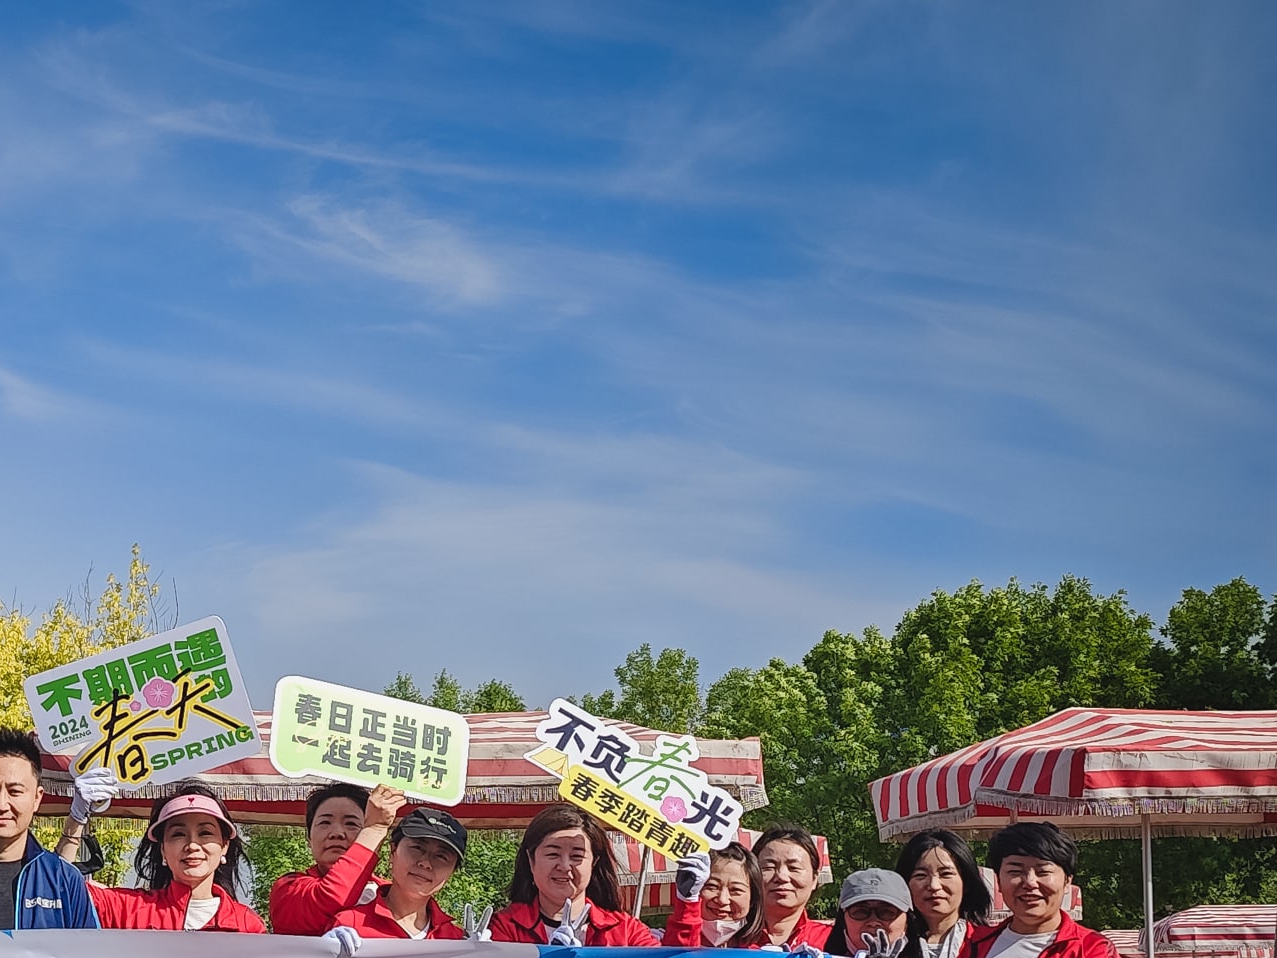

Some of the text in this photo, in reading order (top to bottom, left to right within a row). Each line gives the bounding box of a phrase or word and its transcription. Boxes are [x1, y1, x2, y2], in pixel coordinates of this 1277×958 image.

[36, 627, 227, 717] 不期而遇
[48, 715, 90, 740] 2024
[52, 729, 92, 747] SHINING
[78, 667, 246, 781] 春天
[150, 725, 255, 772] SPRING
[294, 693, 452, 756] 春日正当时
[291, 733, 449, 790] 一起去骑行
[544, 707, 736, 842] 不负春光
[570, 772, 701, 860] 春季踏青趣
